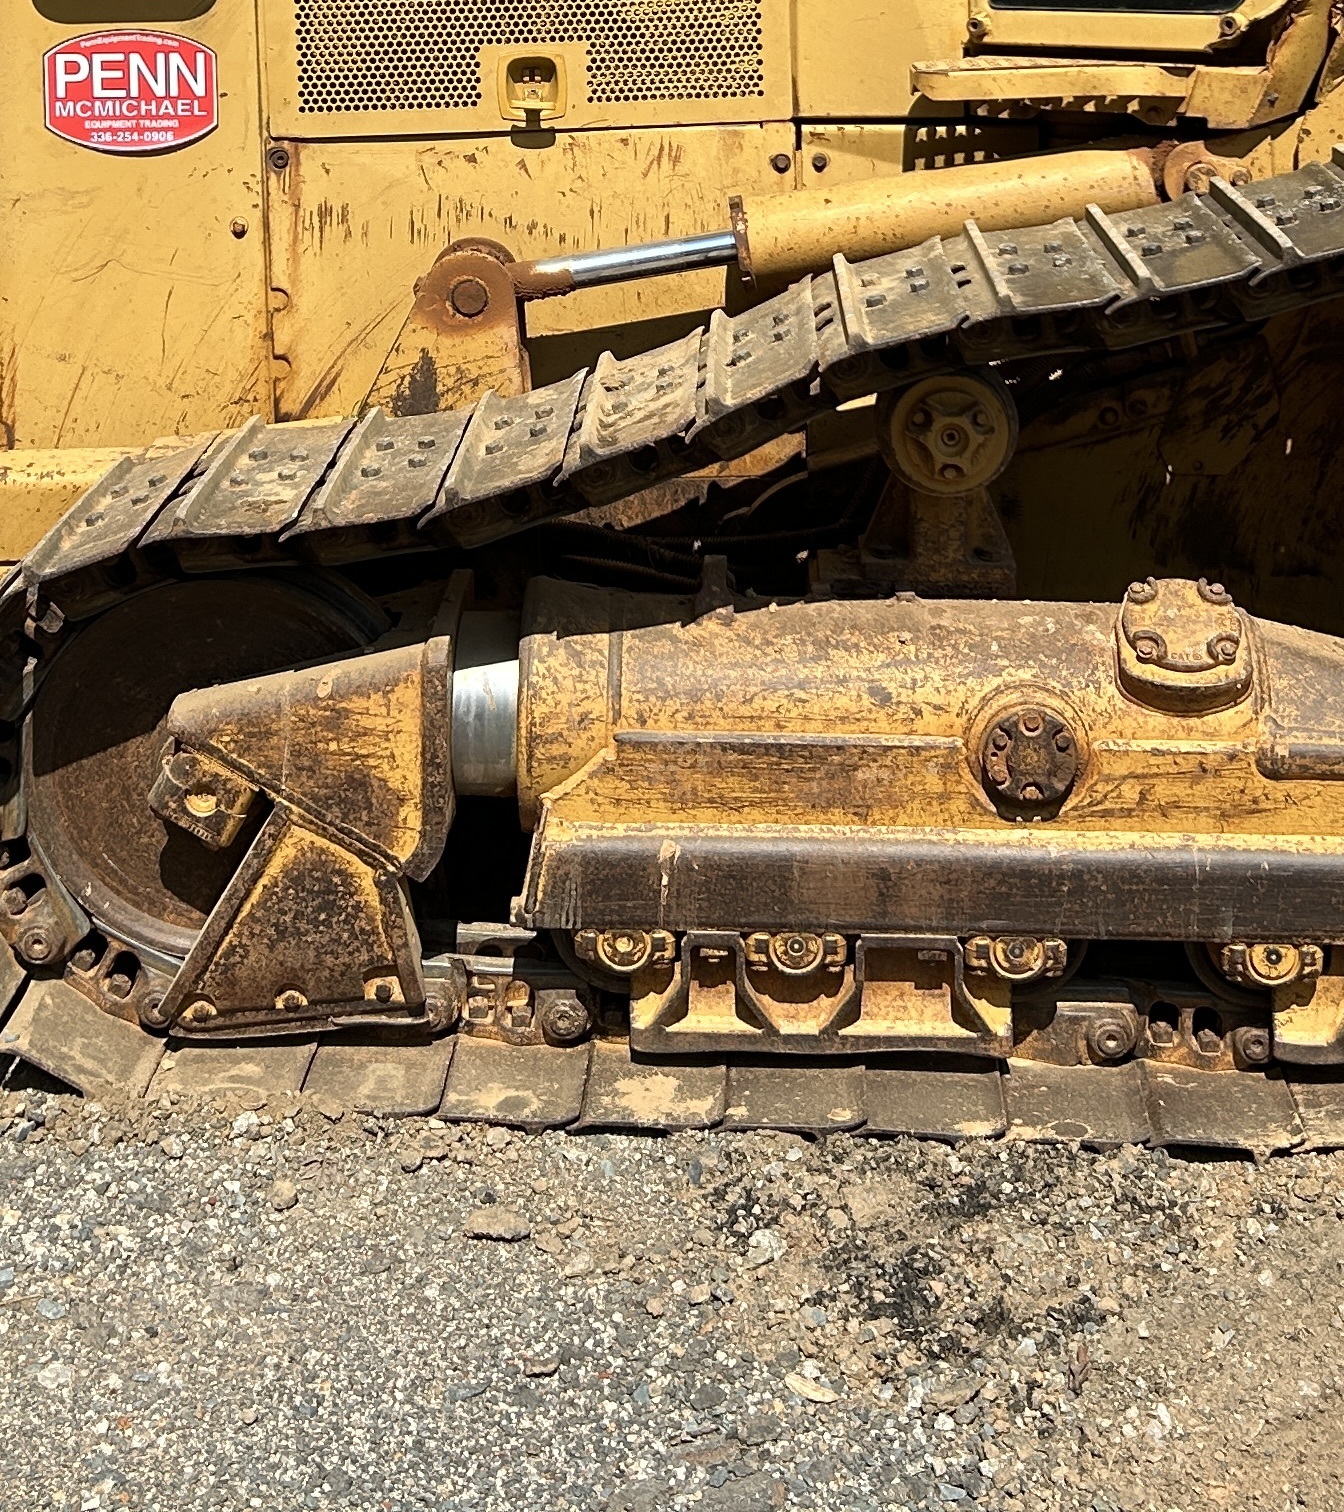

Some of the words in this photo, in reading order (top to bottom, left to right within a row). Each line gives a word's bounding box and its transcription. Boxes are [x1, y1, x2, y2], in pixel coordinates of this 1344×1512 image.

[56, 52, 206, 98] PENN
[55, 100, 207, 117] MCMICHAEL
[85, 120, 137, 129] EQUIPMENT
[139, 119, 179, 128] TRADING
[90, 131, 174, 142] 336-254-0906
